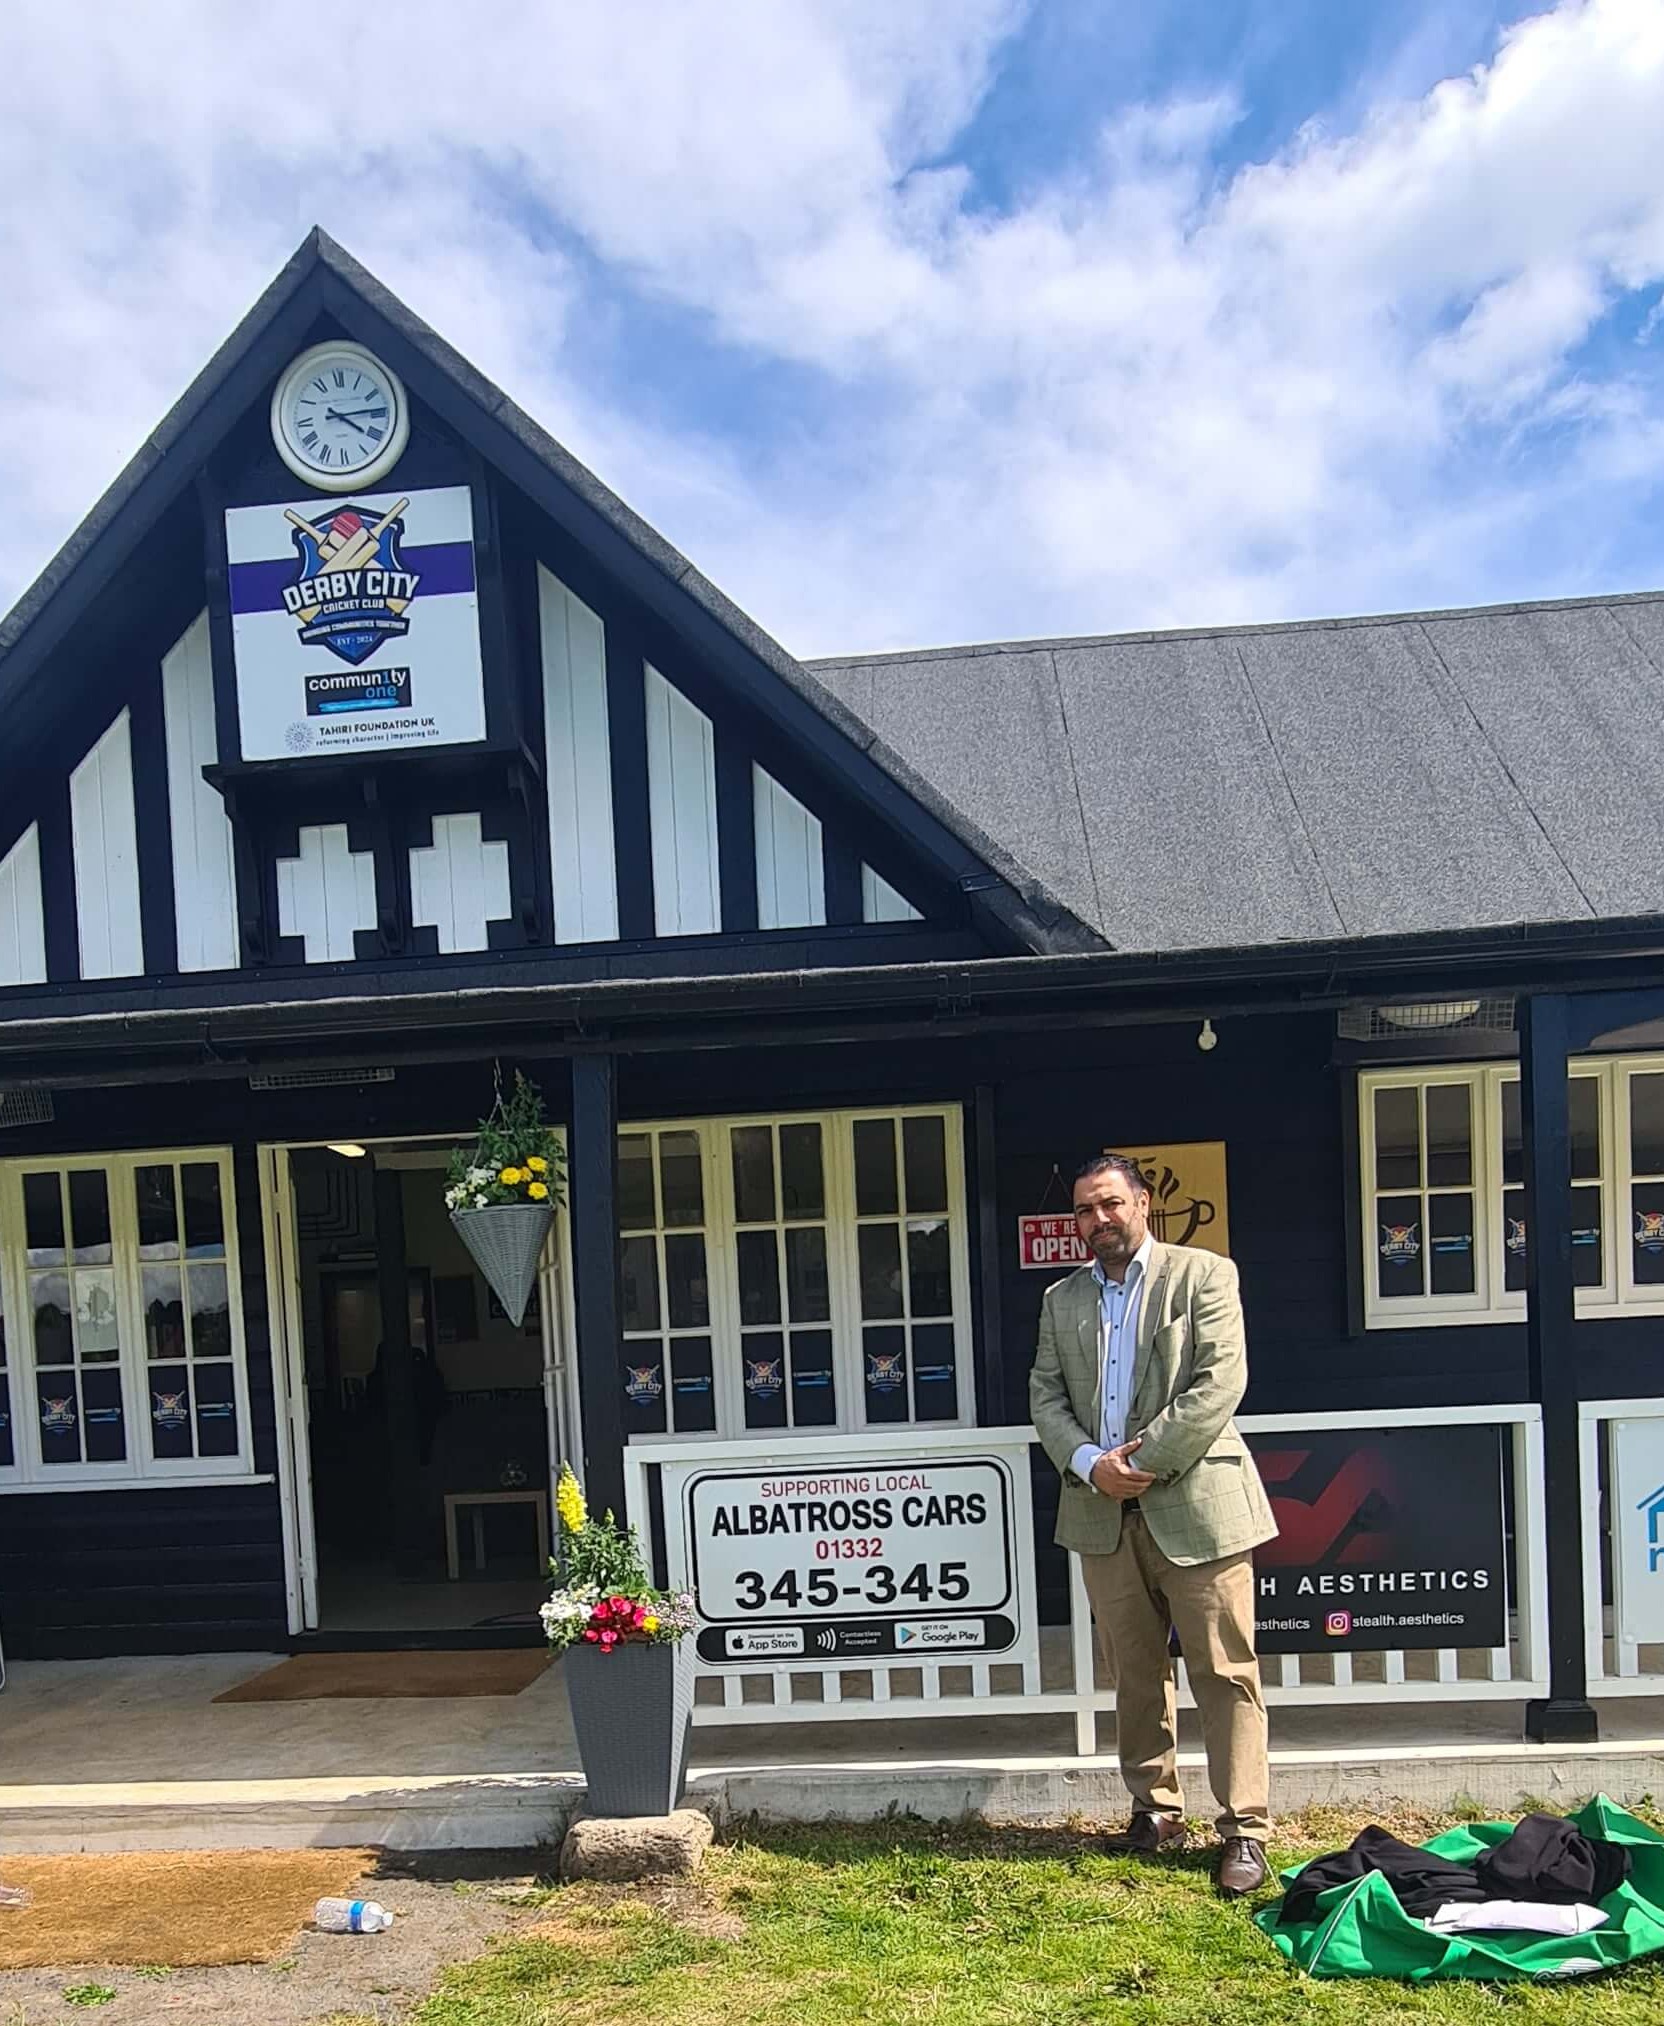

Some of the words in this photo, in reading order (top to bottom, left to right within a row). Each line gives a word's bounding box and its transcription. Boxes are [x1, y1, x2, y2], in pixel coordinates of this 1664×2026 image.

[282, 571, 361, 612] DERBY
[366, 571, 420, 598] CITY
[323, 599, 360, 613] CRICKET
[362, 599, 385, 609] CLUB
[366, 685, 397, 698] one
[320, 725, 352, 736] TAHIRI
[355, 719, 418, 732] FOUNDATION
[421, 718, 435, 727] UK
[1032, 1236, 1087, 1261] OPEN
[761, 1477, 870, 1498] SUPPORTING
[875, 1474, 932, 1492] LOCAL
[712, 1499, 893, 1537] ALBATROSS
[902, 1493, 987, 1528] CARS
[816, 1538, 883, 1561] 01332
[734, 1561, 970, 1611] 345-345
[1297, 1570, 1490, 1595] AESTHETICS
[1254, 1618, 1311, 1631] esthetics
[1352, 1612, 1465, 1629] stealth.aesthetics
[748, 1640, 769, 1650] App
[771, 1639, 798, 1649] Store
[922, 1632, 957, 1643] Google
[958, 1631, 979, 1642] Play
